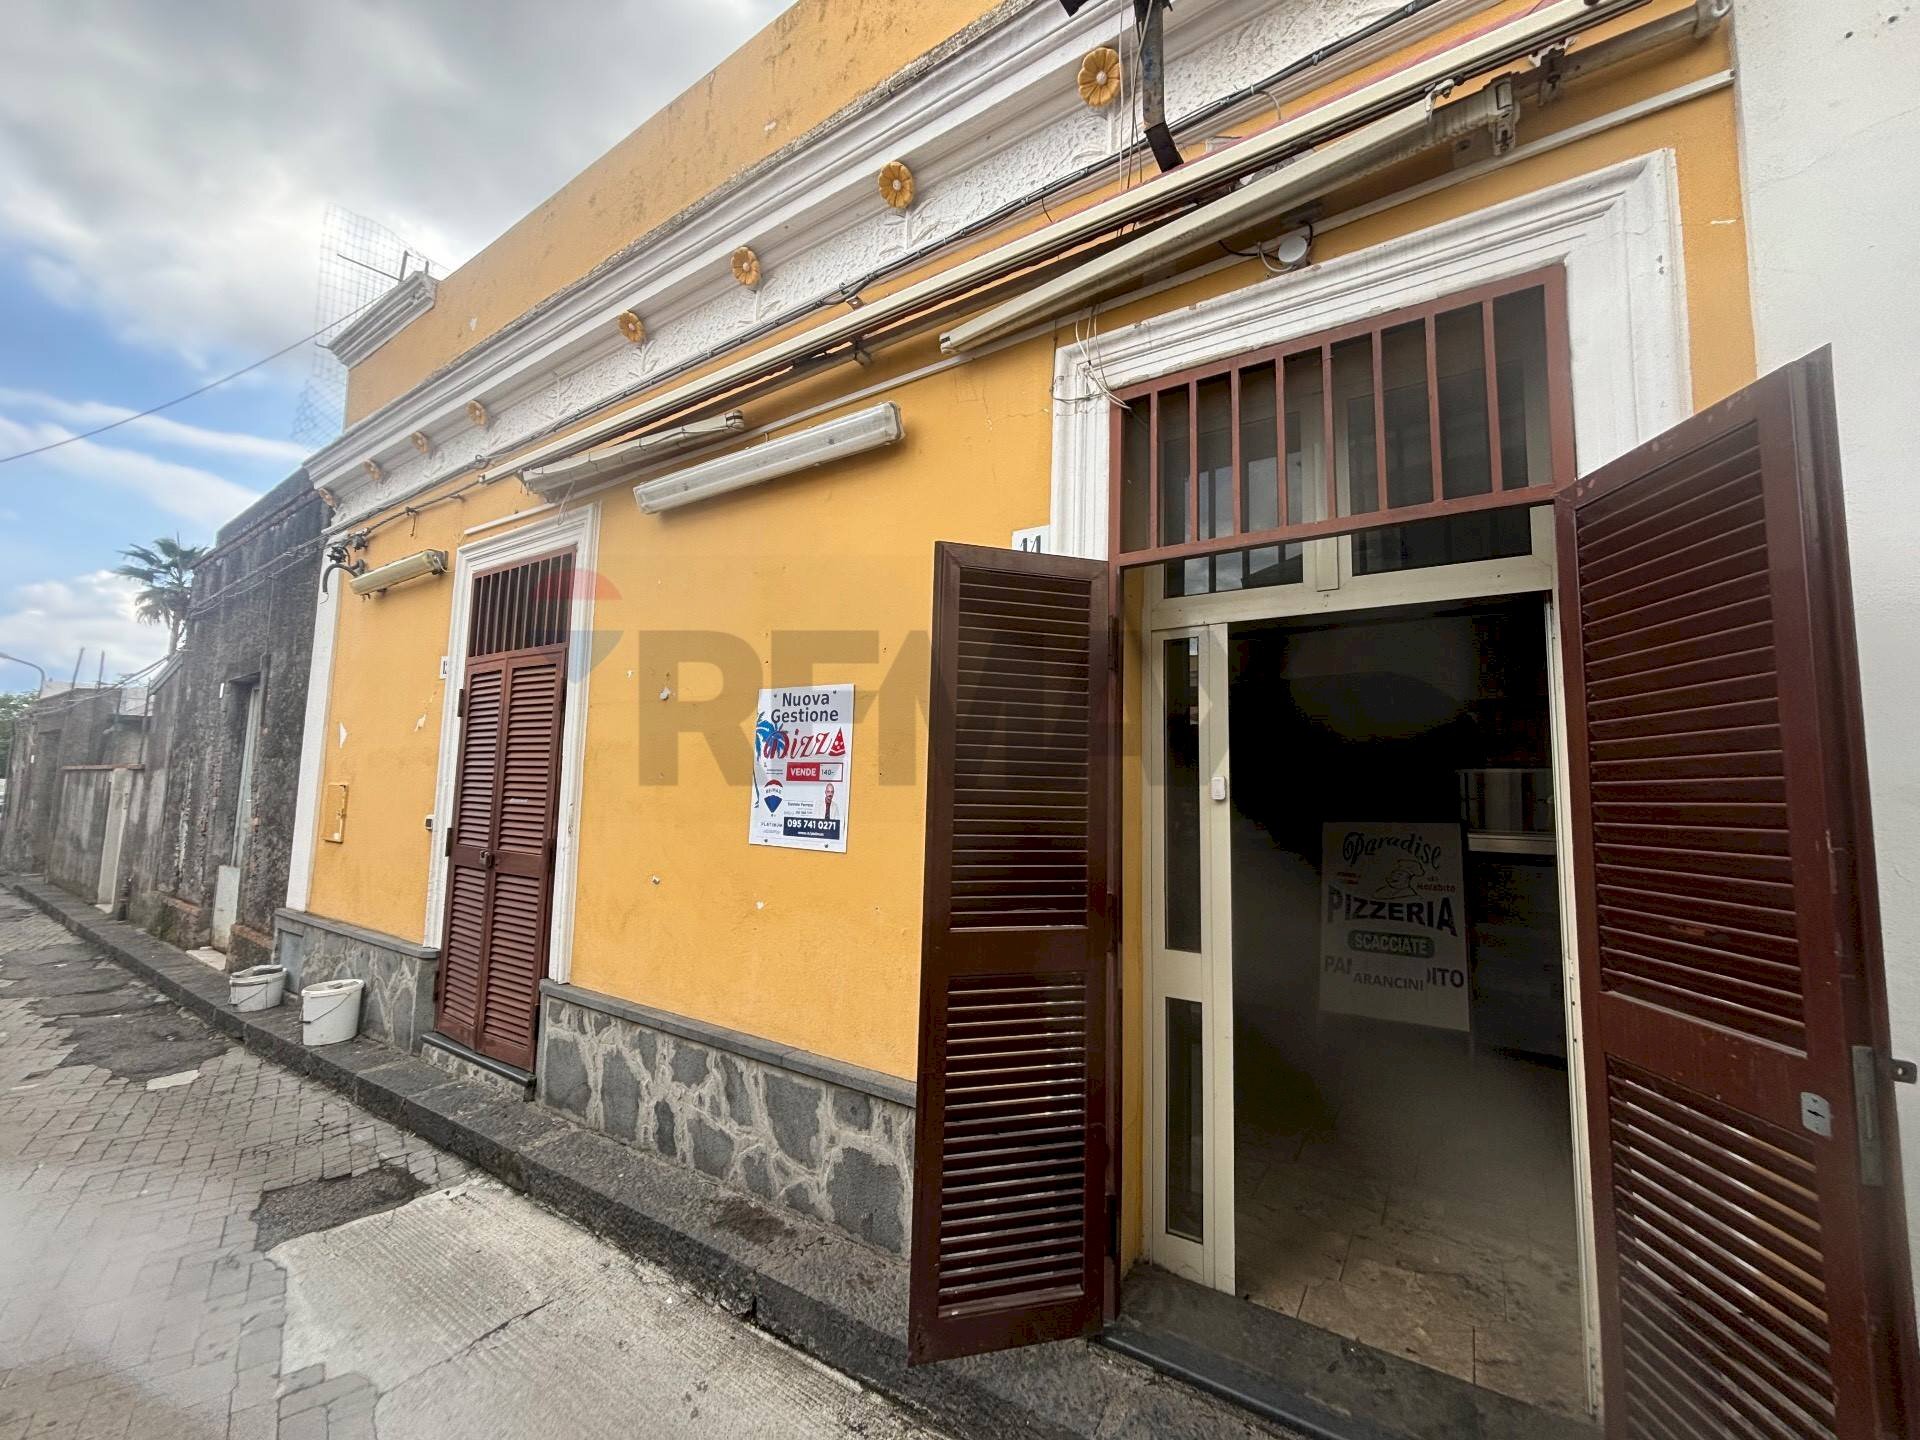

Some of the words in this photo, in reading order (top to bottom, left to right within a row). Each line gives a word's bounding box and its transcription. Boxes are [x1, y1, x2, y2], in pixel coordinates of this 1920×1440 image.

[782, 692, 830, 707] Nuova
[770, 707, 839, 724] Gestione
[790, 767, 817, 777] VENDE
[787, 819, 802, 828] 095
[803, 820, 816, 829] 741
[817, 821, 836, 830] 0271
[1343, 831, 1441, 870] Paradise
[1328, 885, 1458, 937] PIZZERIA
[1354, 934, 1429, 954] SCACCIATE
[1352, 971, 1425, 991] ARANCINI
